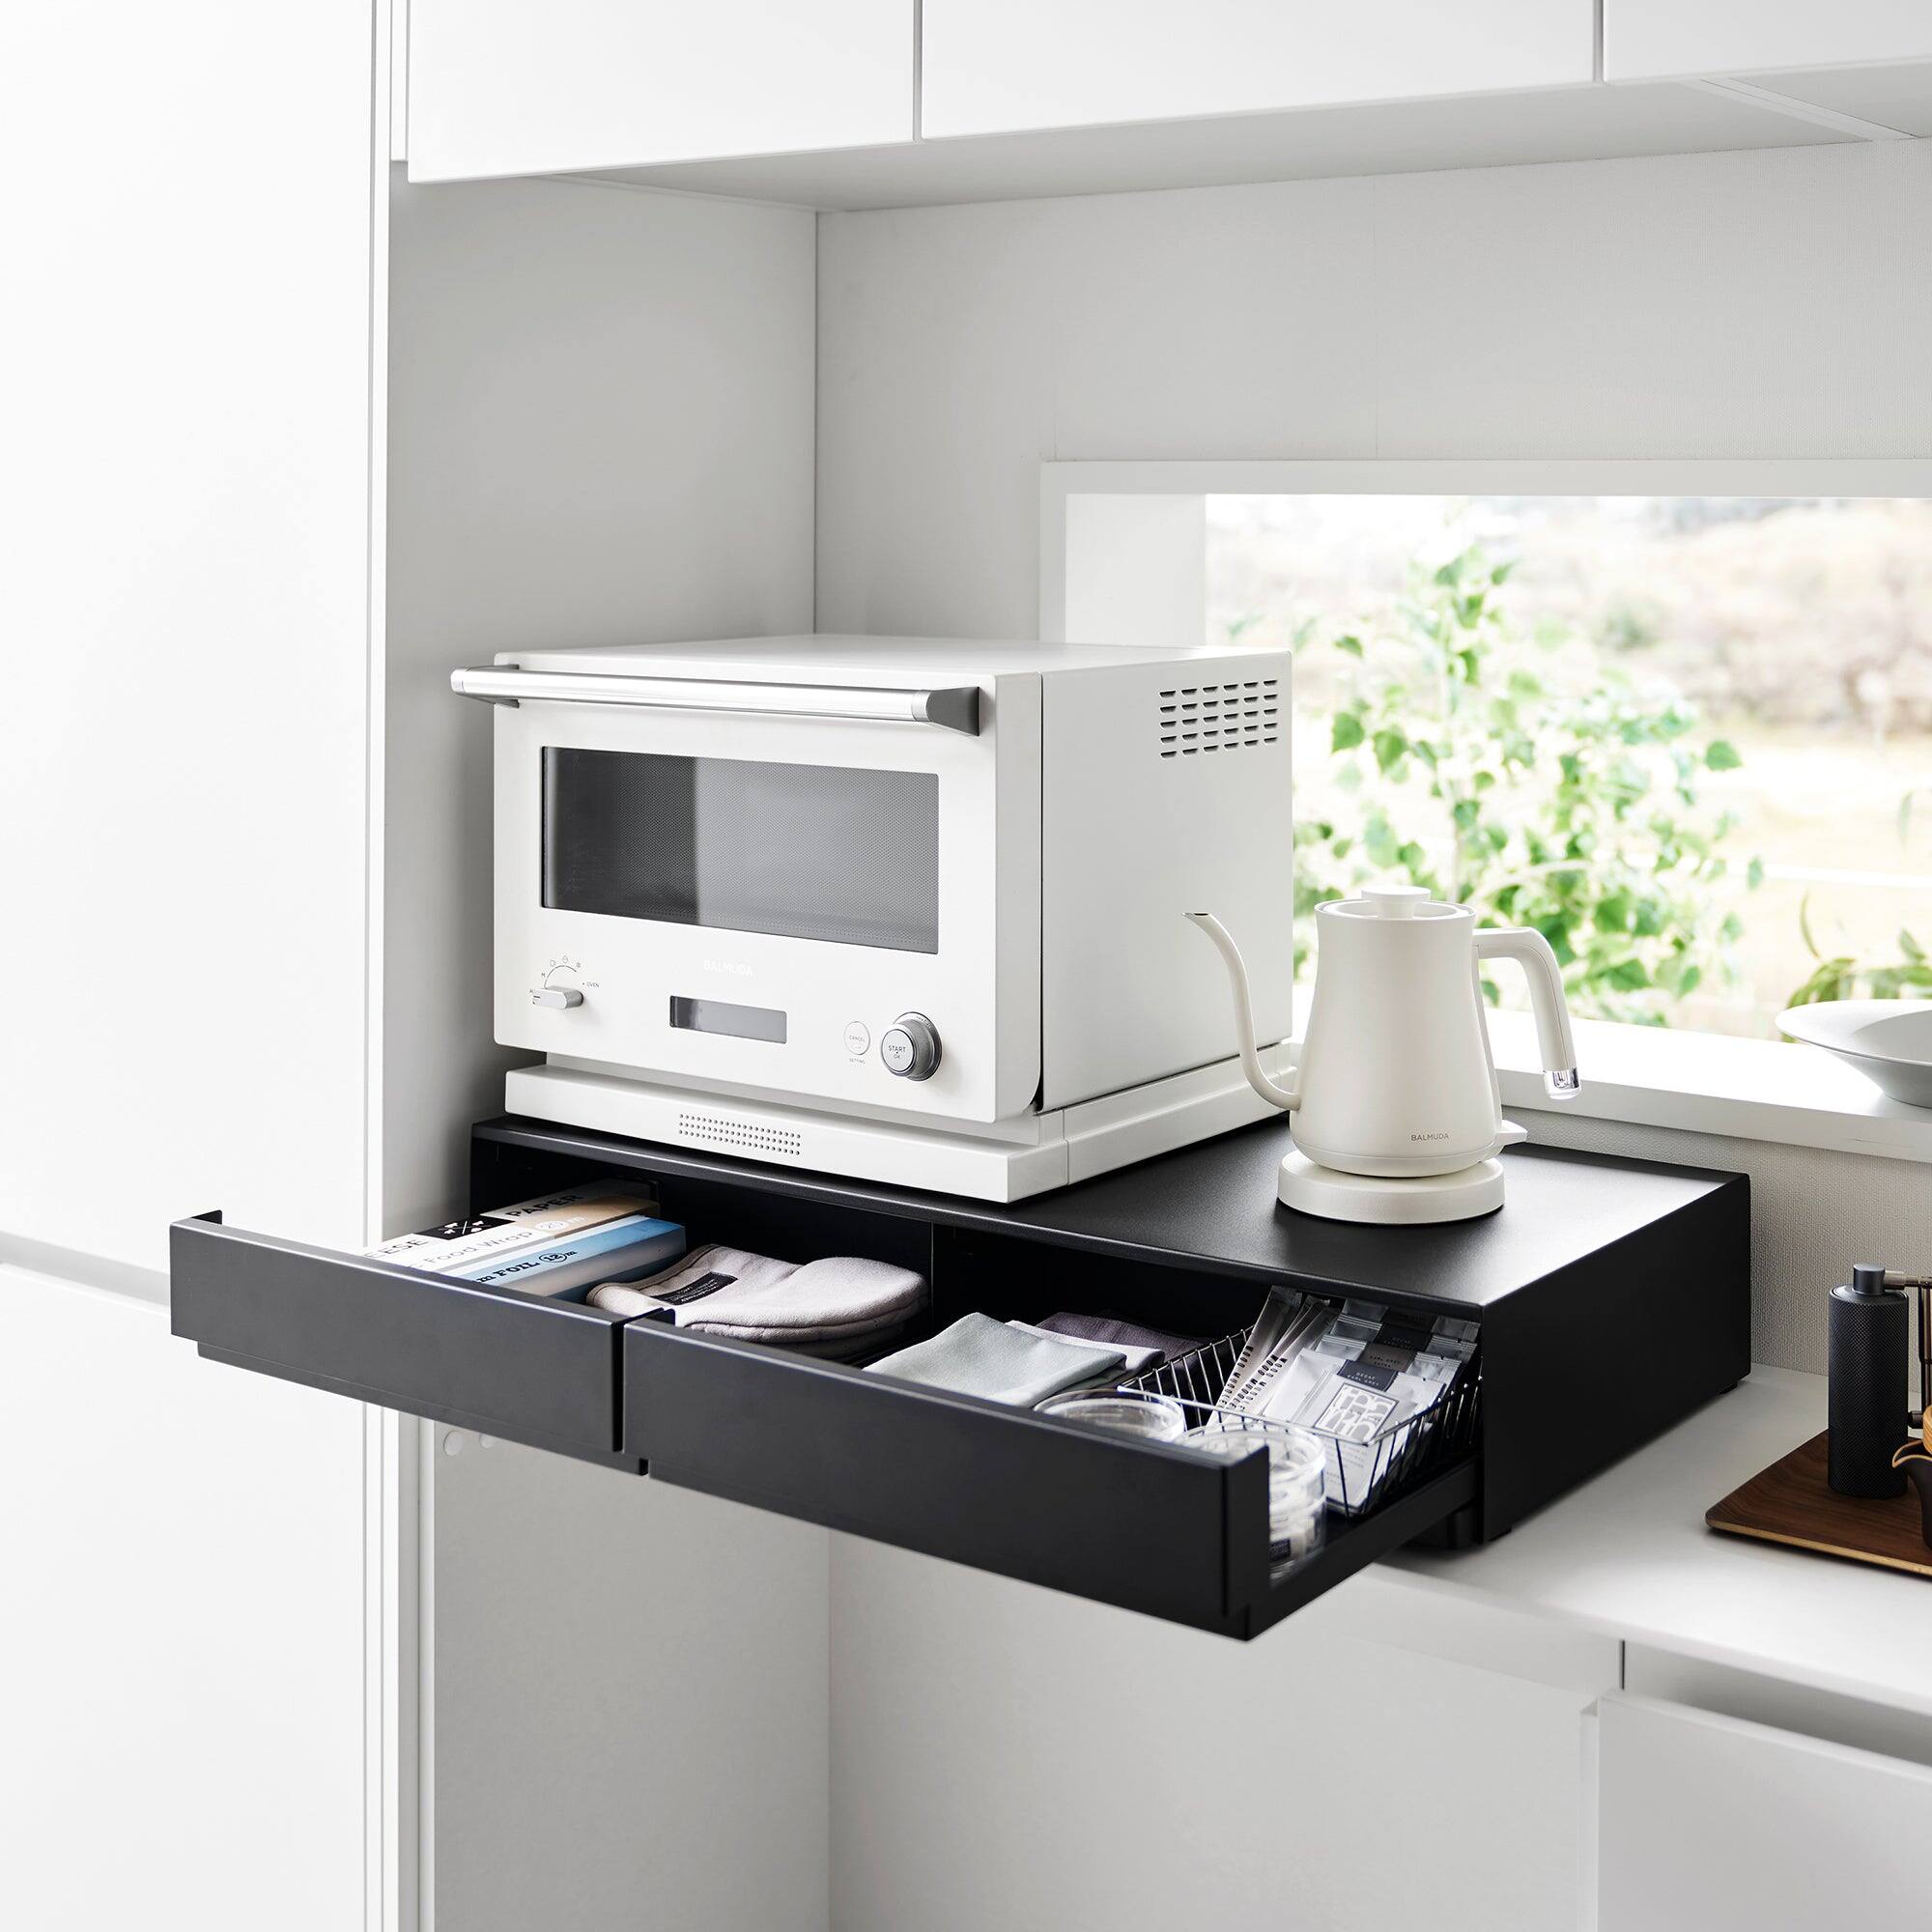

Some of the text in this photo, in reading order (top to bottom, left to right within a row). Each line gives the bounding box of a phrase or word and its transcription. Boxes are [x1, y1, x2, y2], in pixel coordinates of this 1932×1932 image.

[703, 959, 753, 977] BALMUDA
[1410, 1132, 1450, 1142] BALMUDA
[505, 1195, 584, 1217] PAPER
[493, 1262, 541, 1277] FOIL
[1236, 1381, 1267, 1410] MUDDLE
